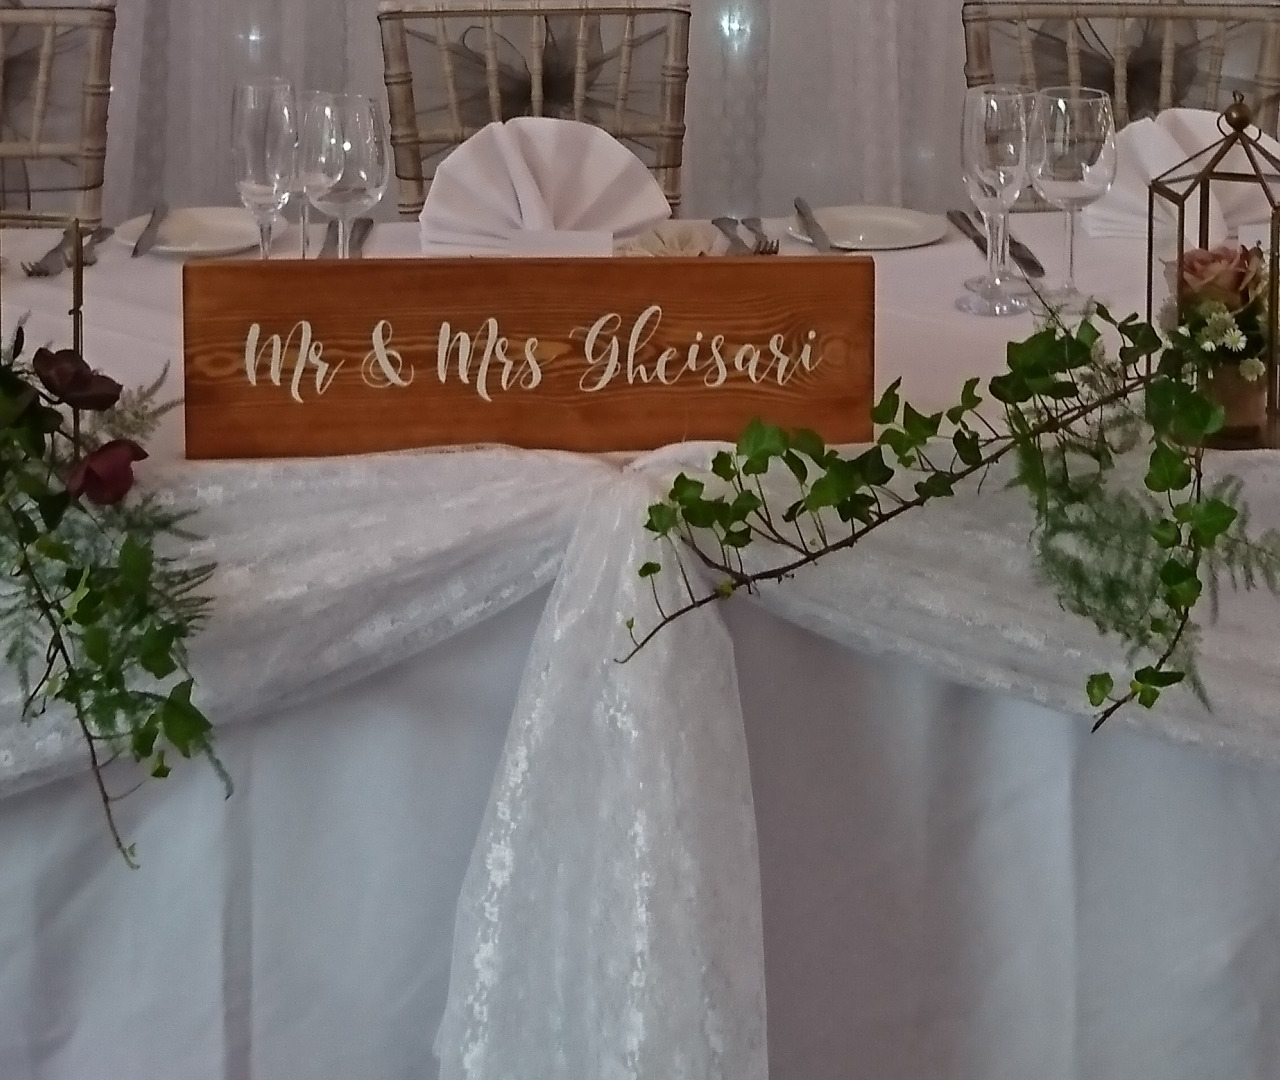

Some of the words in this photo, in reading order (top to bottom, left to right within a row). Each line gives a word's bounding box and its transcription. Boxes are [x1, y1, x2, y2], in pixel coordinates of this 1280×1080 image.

[245, 320, 346, 403] Mr
[361, 320, 414, 389] &
[437, 317, 551, 402] Mrs
[569, 305, 823, 392] Gheisari
